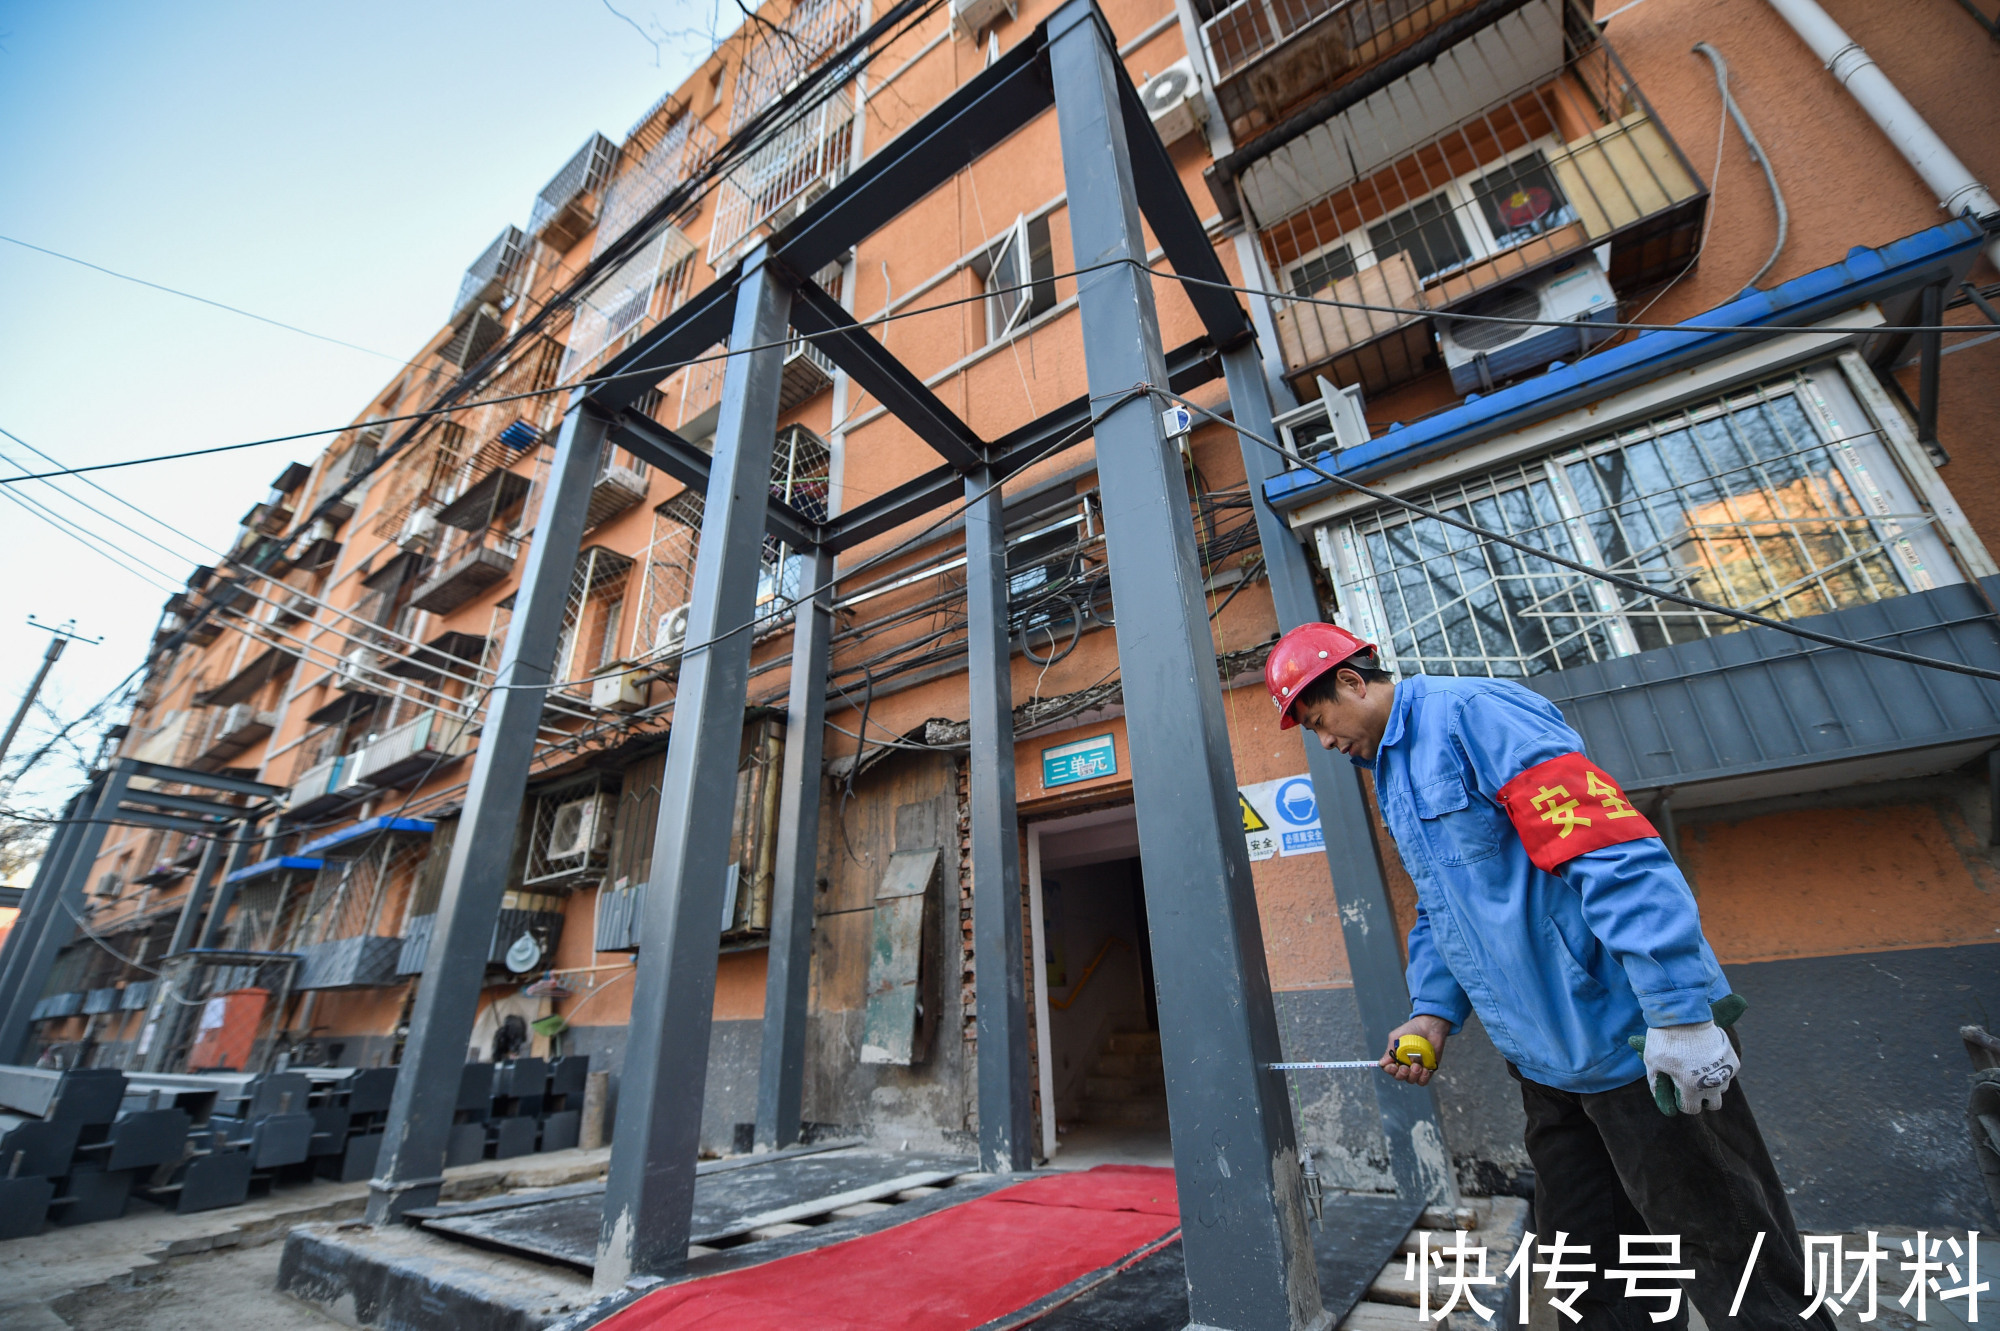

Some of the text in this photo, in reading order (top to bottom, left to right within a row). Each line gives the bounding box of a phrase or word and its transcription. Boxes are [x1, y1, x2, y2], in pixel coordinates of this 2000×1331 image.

[1051, 755, 1108, 780] 三单元
[1529, 770, 1639, 840] 安全
